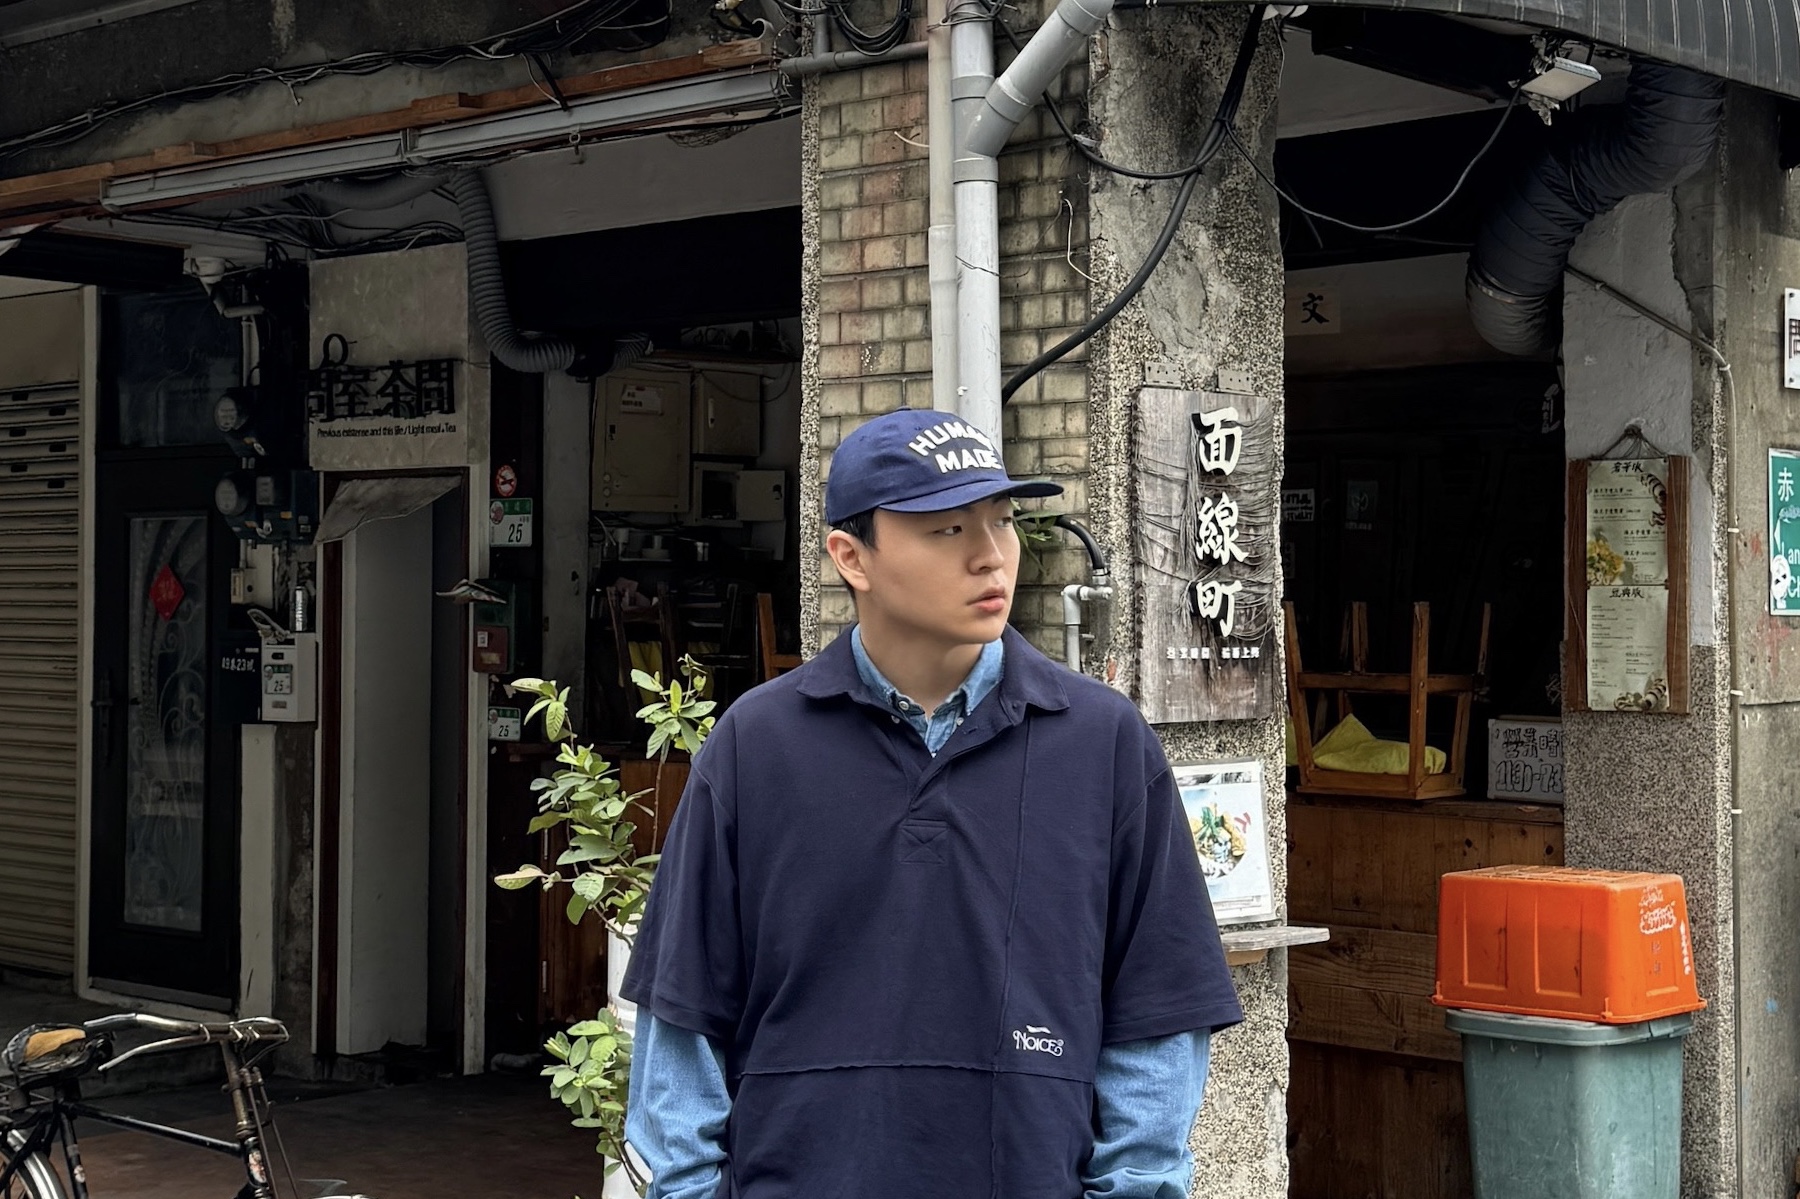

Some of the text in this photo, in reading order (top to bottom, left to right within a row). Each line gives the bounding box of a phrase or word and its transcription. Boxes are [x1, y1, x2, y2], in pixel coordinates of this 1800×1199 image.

[1301, 292, 1329, 323] 文
[934, 448, 1003, 474] MADE
[1777, 466, 1795, 502] 赤
[508, 523, 524, 543] 25
[1195, 406, 1249, 638] 面線町
[498, 725, 509, 737] 25
[1502, 728, 1563, 758] 營業時
